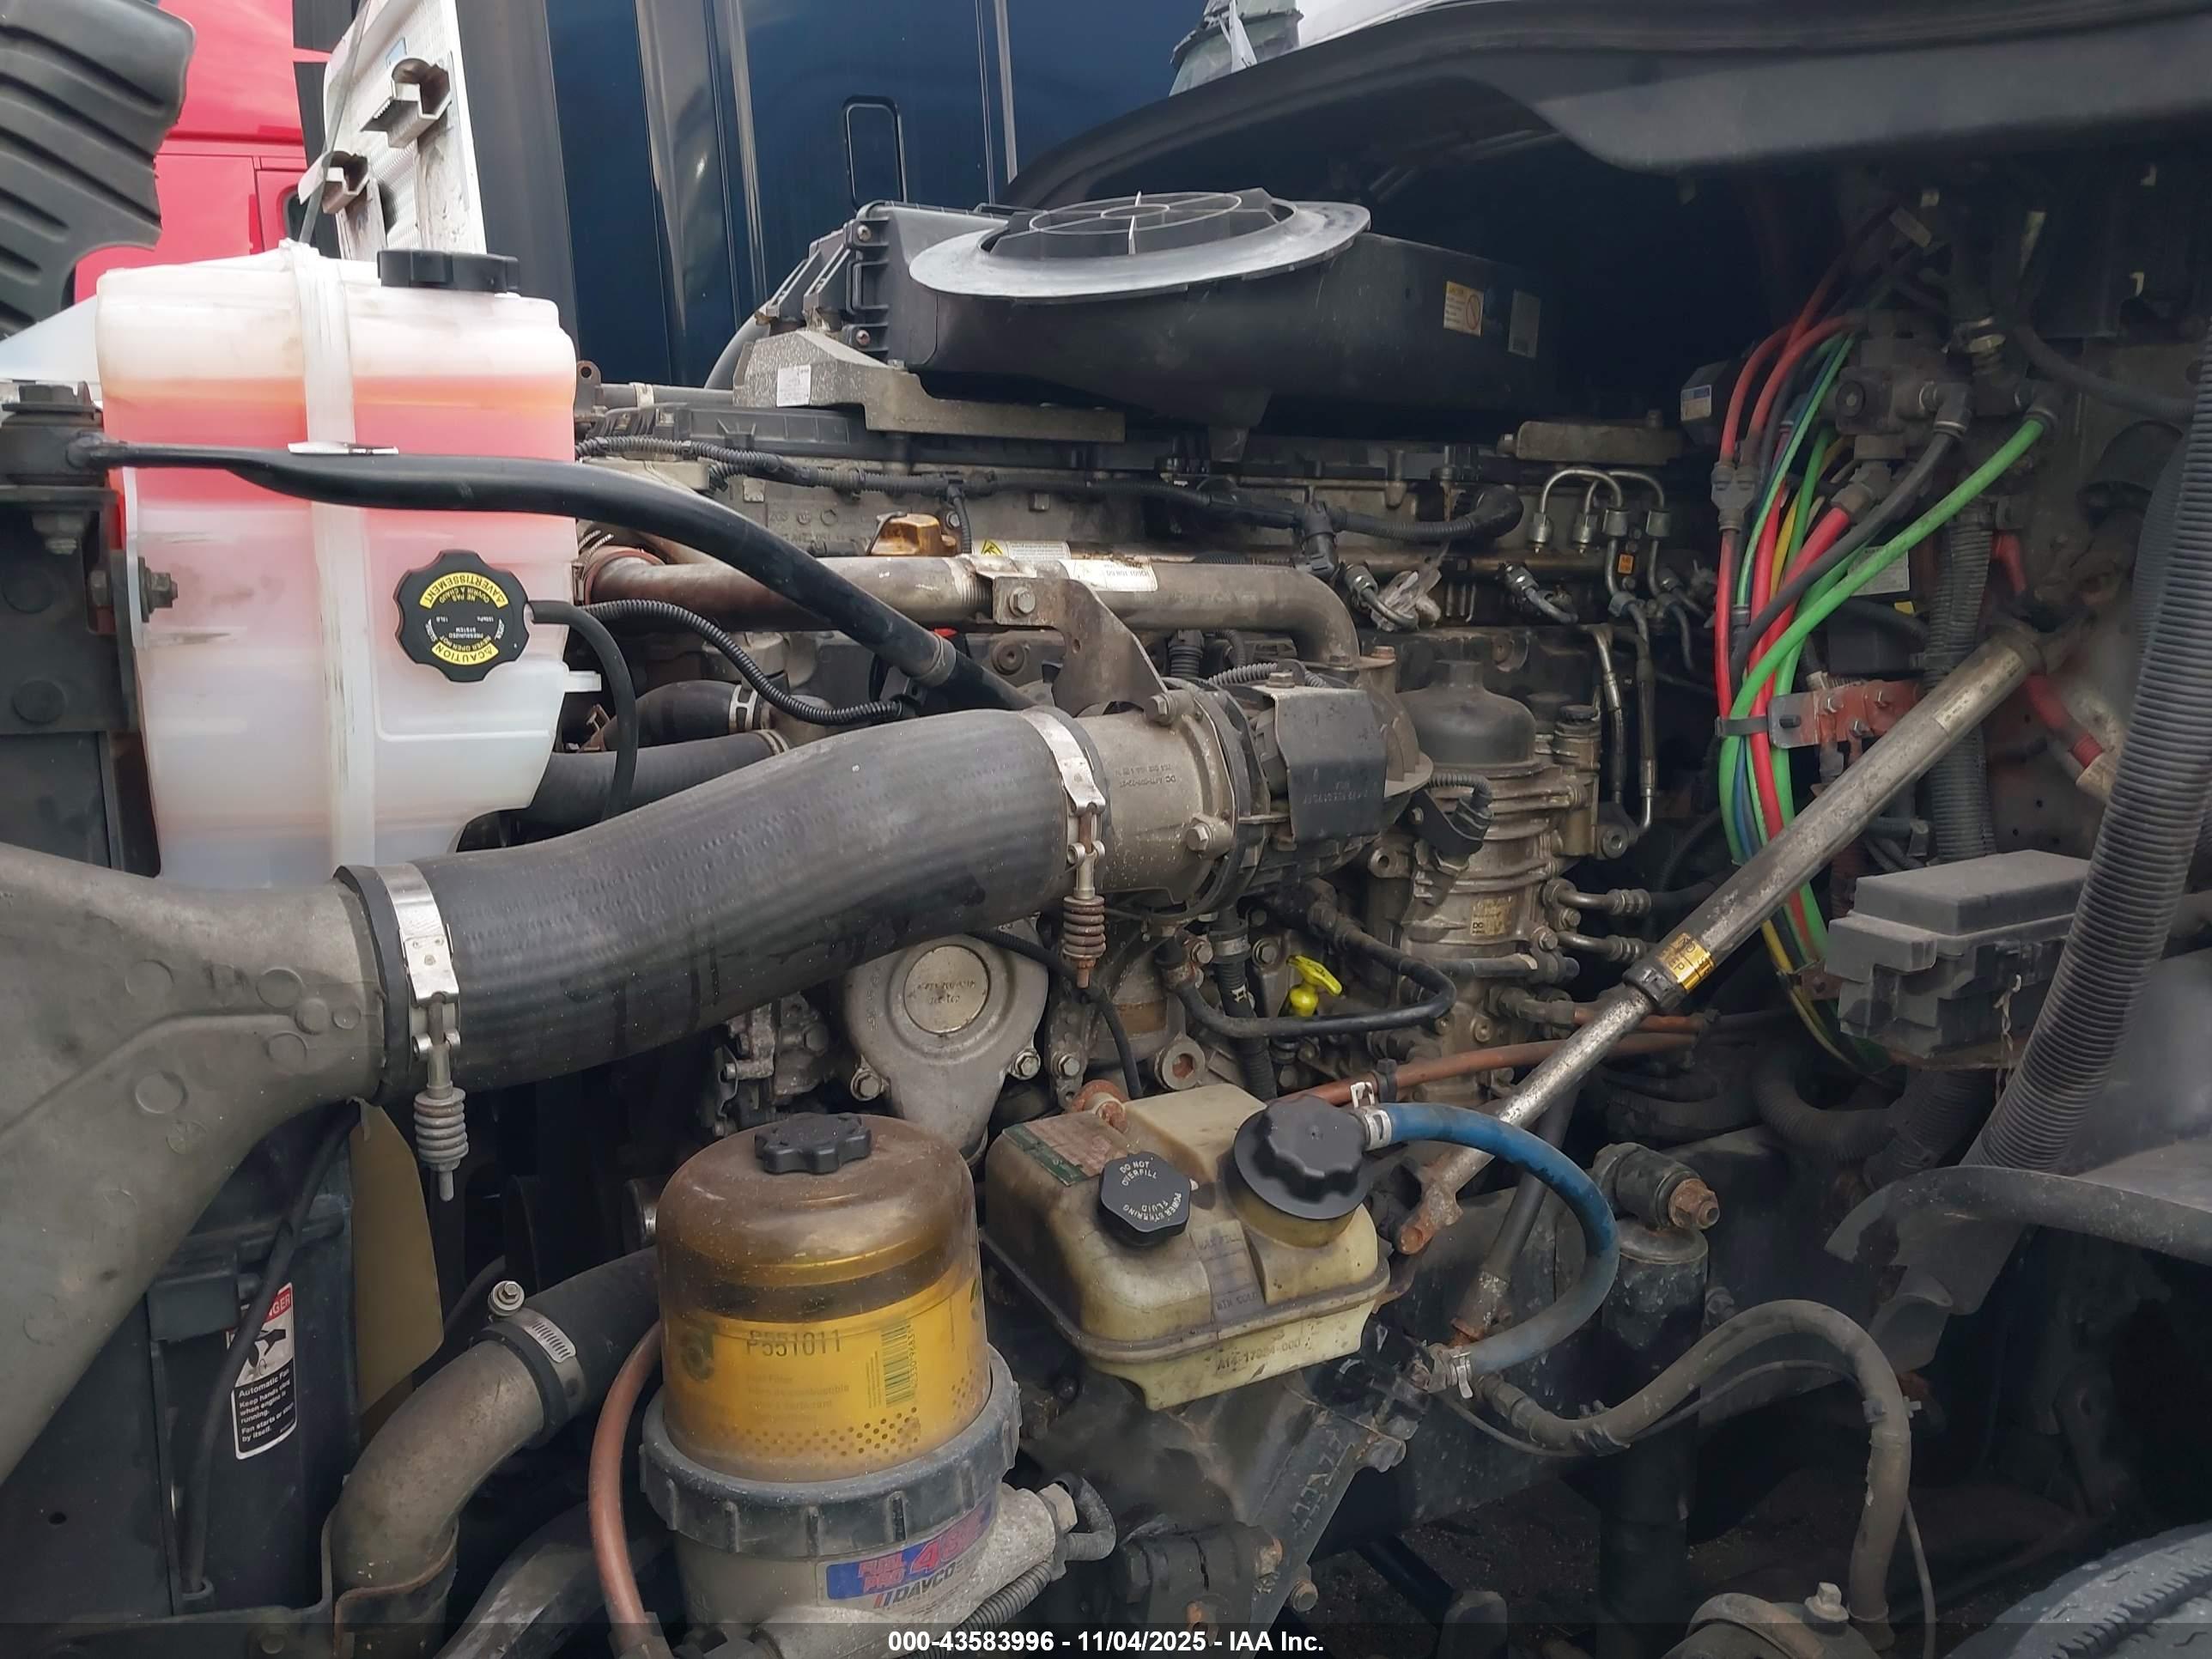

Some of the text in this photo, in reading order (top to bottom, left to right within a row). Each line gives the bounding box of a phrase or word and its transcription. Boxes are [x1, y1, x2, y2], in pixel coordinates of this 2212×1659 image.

[424, 574, 500, 602] AVERTISSEMENT
[453, 642, 471, 652] OPEN
[471, 635, 492, 651] NEVER
[436, 646, 486, 663] CAUTION
[1120, 1160, 1150, 1174] DO NOT
[1121, 1169, 1158, 1186] OVERFILL
[1122, 1192, 1182, 1222] POWER STEERING
[1141, 1200, 1169, 1212] FLUID
[747, 1329, 842, 1358] P551011
[239, 1376, 279, 1398] Automatic
[240, 1398, 258, 1408] Keep
[259, 1389, 279, 1401] hands
[240, 1406, 259, 1416] when
[260, 1395, 281, 1409] engine
[240, 1409, 270, 1424] running.
[241, 1425, 255, 1434] Fan
[256, 1417, 276, 1429] starts
[863, 1569, 905, 1592] PRO
[893, 1561, 956, 1603] DAVCO
